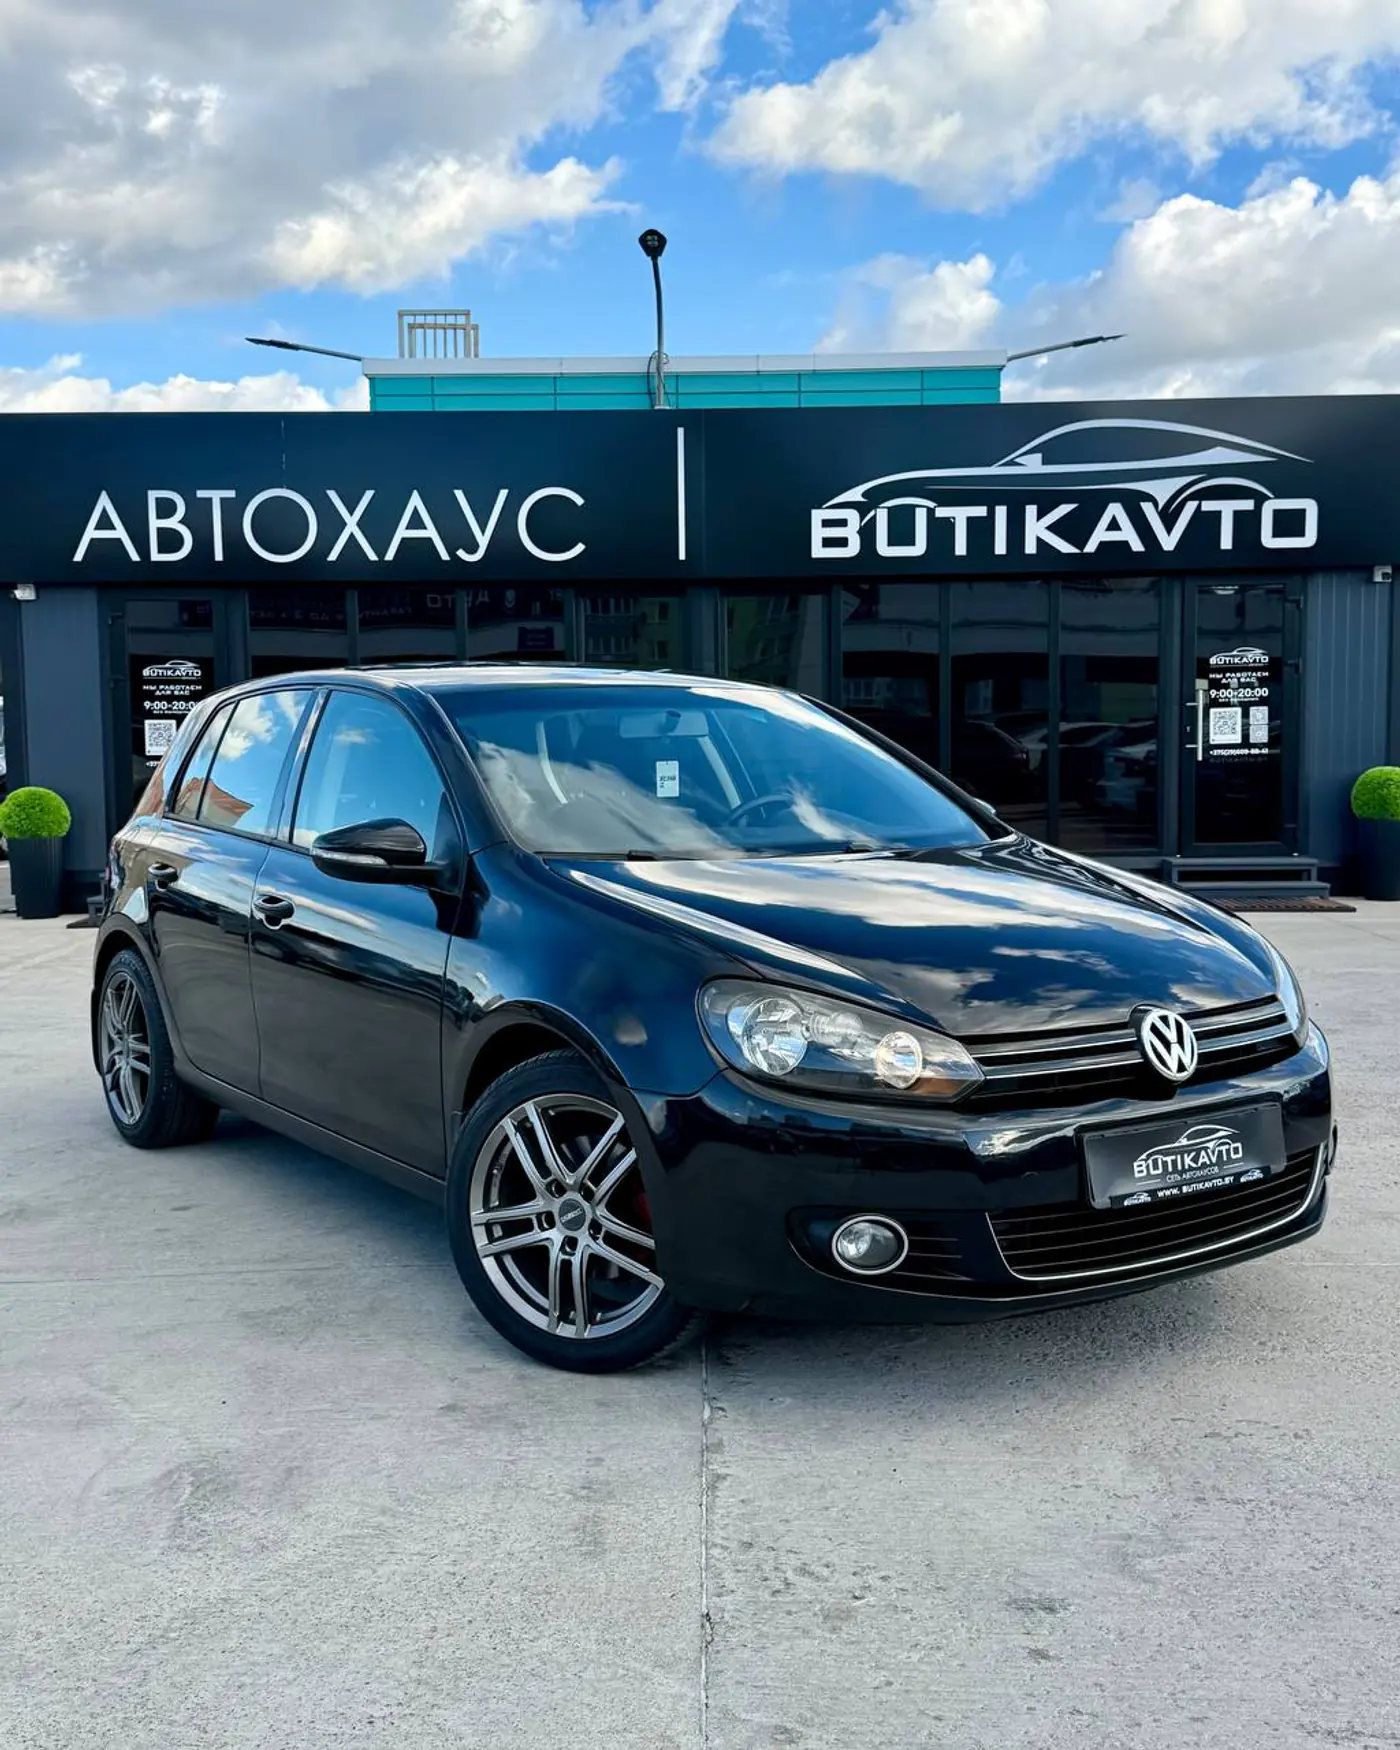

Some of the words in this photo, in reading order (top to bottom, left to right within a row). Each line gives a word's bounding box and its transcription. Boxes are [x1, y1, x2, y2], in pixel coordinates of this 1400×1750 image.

[73, 487, 586, 563] АВТОХАУС
[811, 497, 1318, 558] BUTIKAVTO
[1209, 656, 1269, 664] BUTIKAVTO
[142, 668, 202, 677] BUTIKAVTO
[1210, 687, 1269, 698] 9:00-20:00
[144, 701, 199, 710] 9:00-20:0
[1133, 1142, 1243, 1178] BUTIKAVTO
